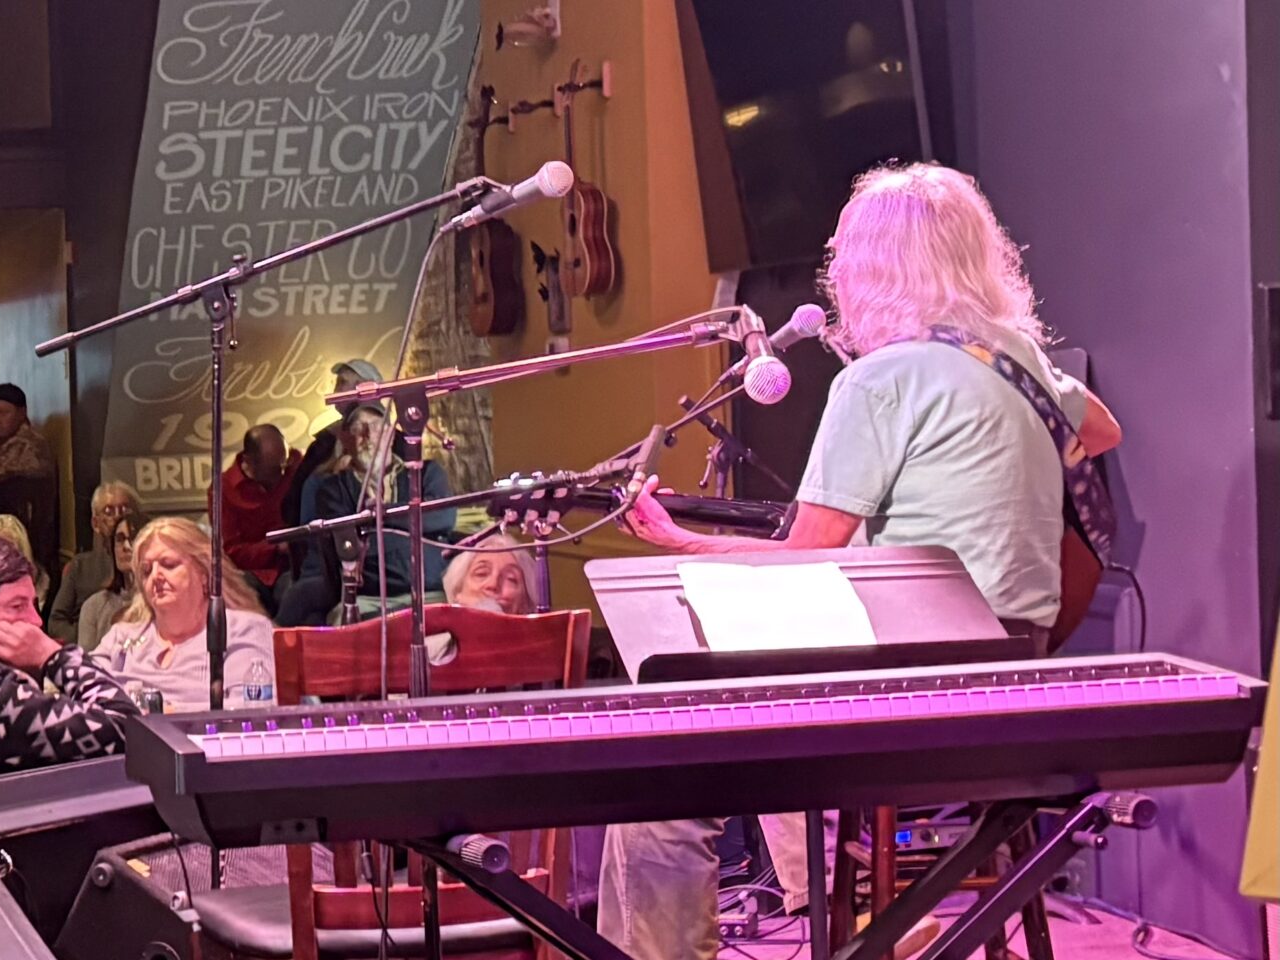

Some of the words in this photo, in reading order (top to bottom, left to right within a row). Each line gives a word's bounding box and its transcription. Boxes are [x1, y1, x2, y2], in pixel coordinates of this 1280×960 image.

[162, 96, 352, 131] PHOENIX
[364, 90, 460, 122] IRON
[163, 178, 253, 214] EAST
[260, 174, 419, 210] PIKELAND
[248, 283, 397, 319] STREET
[134, 455, 237, 492] BRID
